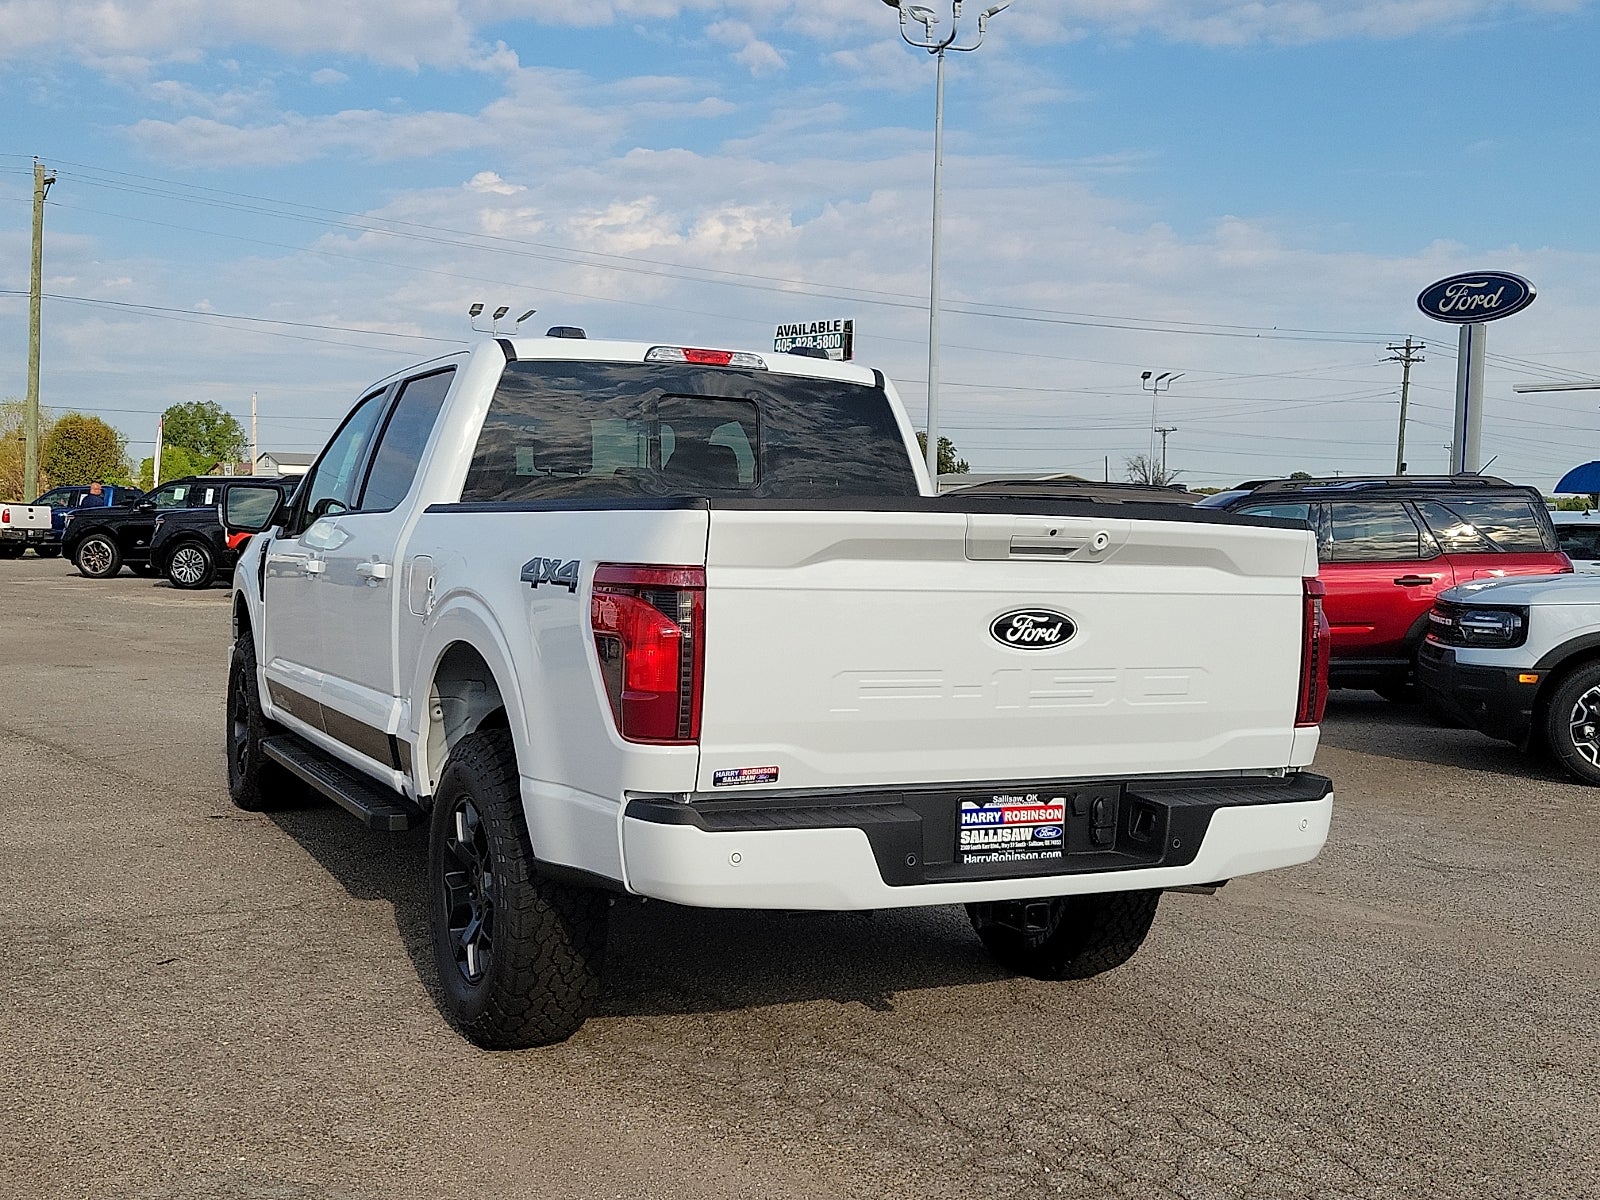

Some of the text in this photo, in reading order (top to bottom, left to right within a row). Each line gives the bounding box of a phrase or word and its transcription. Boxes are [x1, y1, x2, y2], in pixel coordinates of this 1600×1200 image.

[1439, 281, 1504, 312] Ford
[776, 320, 841, 337] AVAILABLE
[775, 334, 840, 352] 405-928-5800
[1006, 614, 1062, 643] Ford
[716, 770, 739, 778] HARRY
[992, 793, 1038, 803] Sallisaw, OK
[961, 809, 1063, 824] HARRY ROBINSON
[960, 828, 1033, 844] SALLISAW
[963, 851, 1062, 864] HarryRobinson.com
